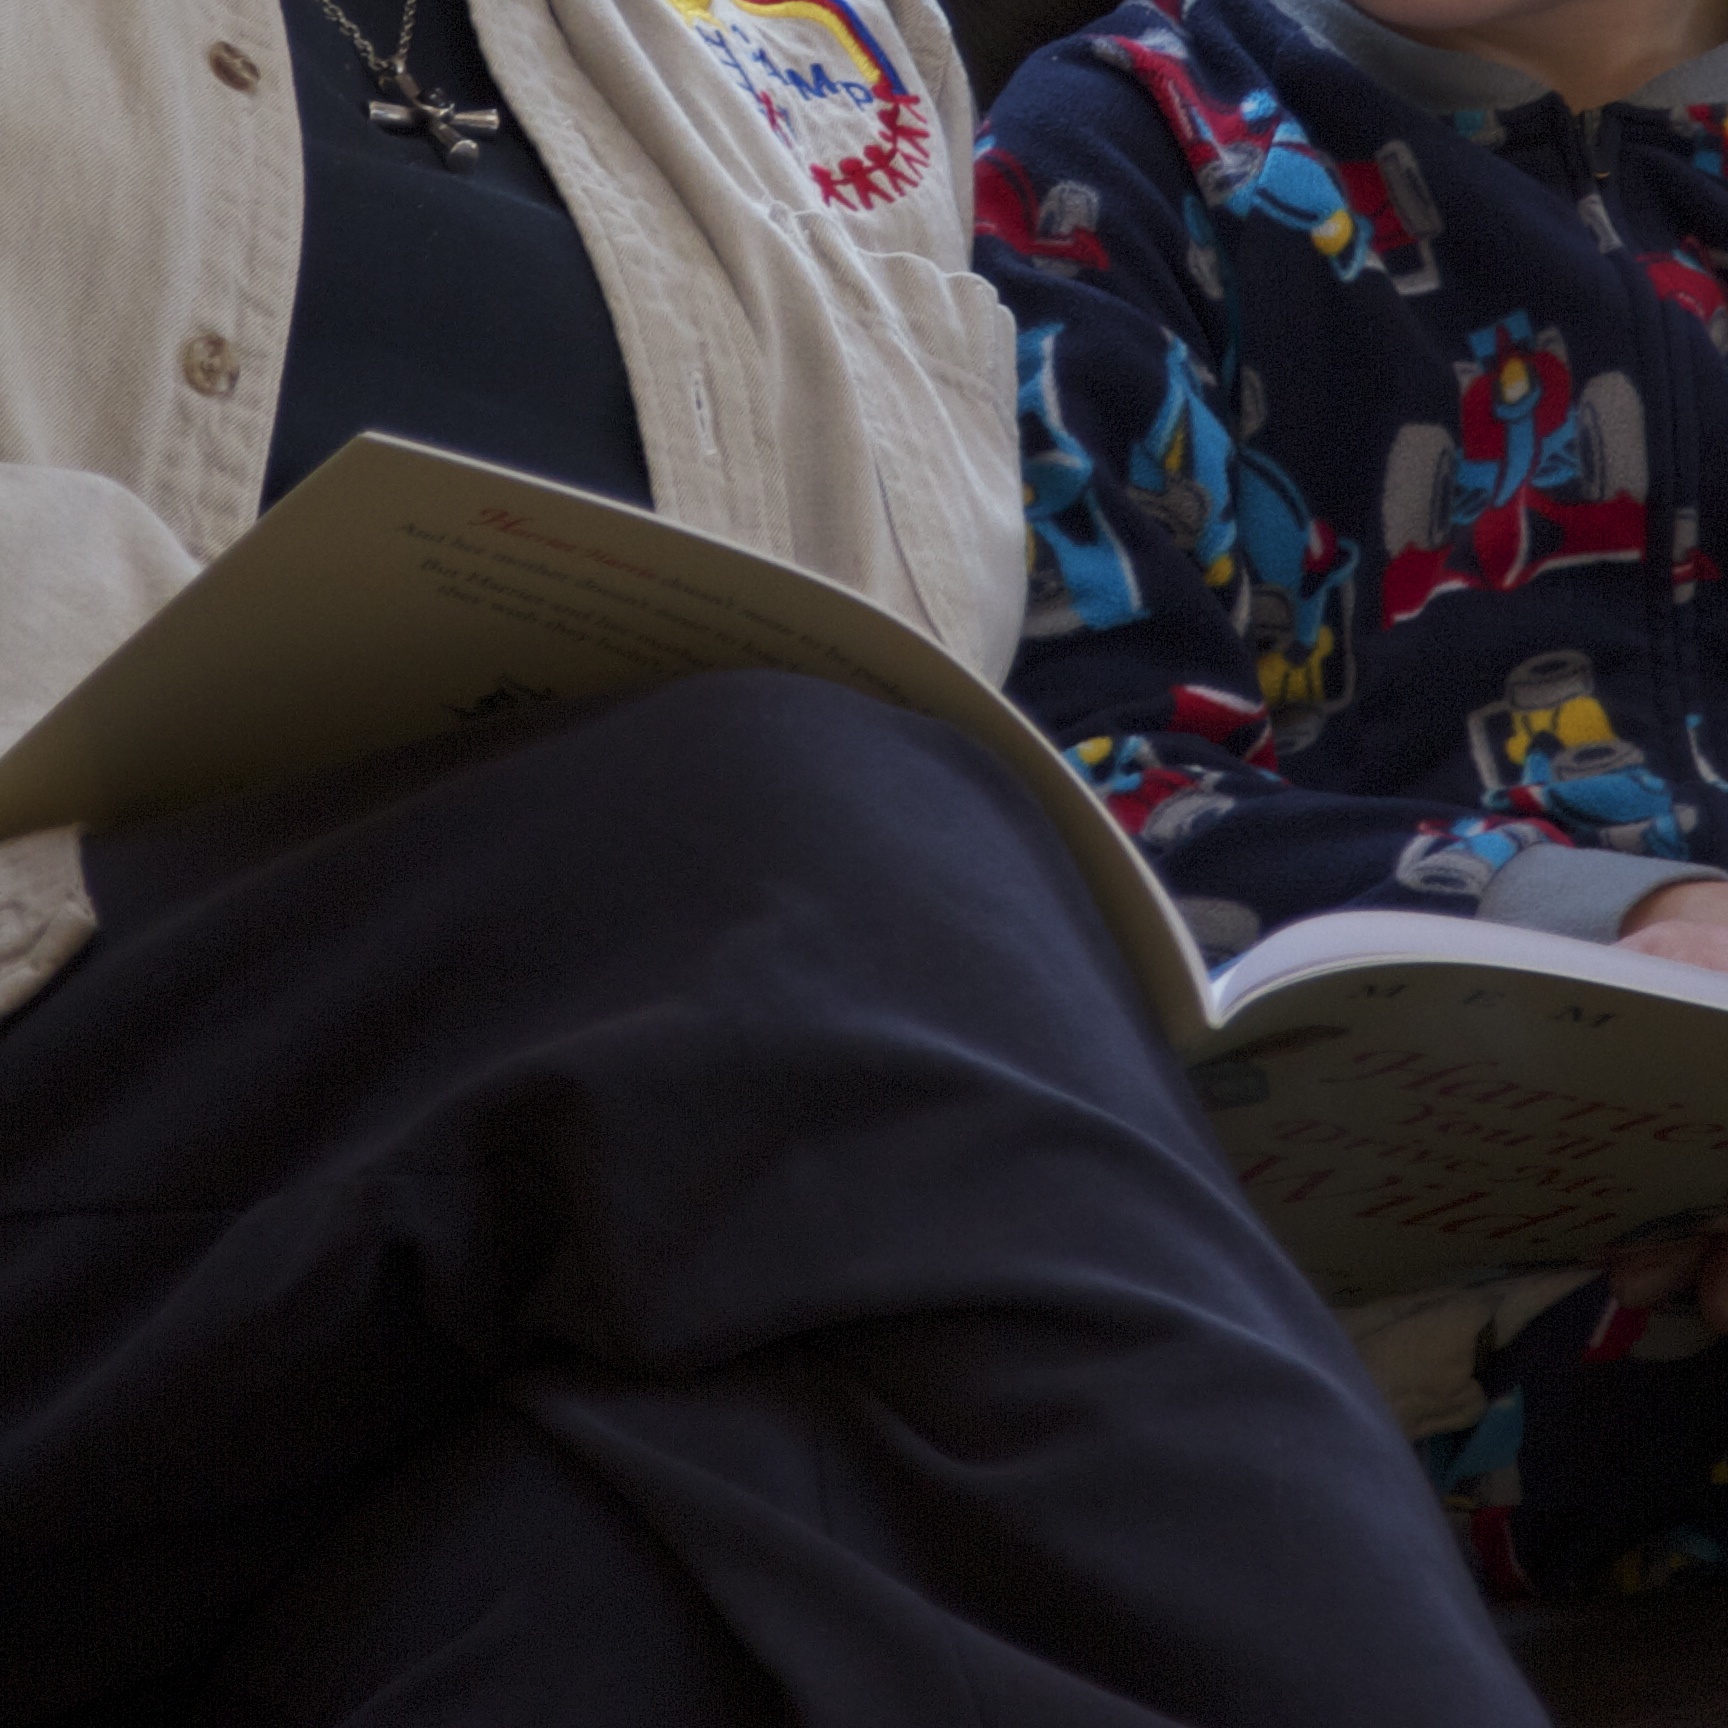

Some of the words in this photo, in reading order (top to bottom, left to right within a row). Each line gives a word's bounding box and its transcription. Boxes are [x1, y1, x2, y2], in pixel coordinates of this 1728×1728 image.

[397, 520, 447, 544] And
[468, 506, 578, 553] Harriet
[1272, 1117, 1491, 1176] Drive
[1488, 1162, 1639, 1200] Me
[1396, 1100, 1621, 1162] You'll
[1230, 1148, 1620, 1246] Wild!
